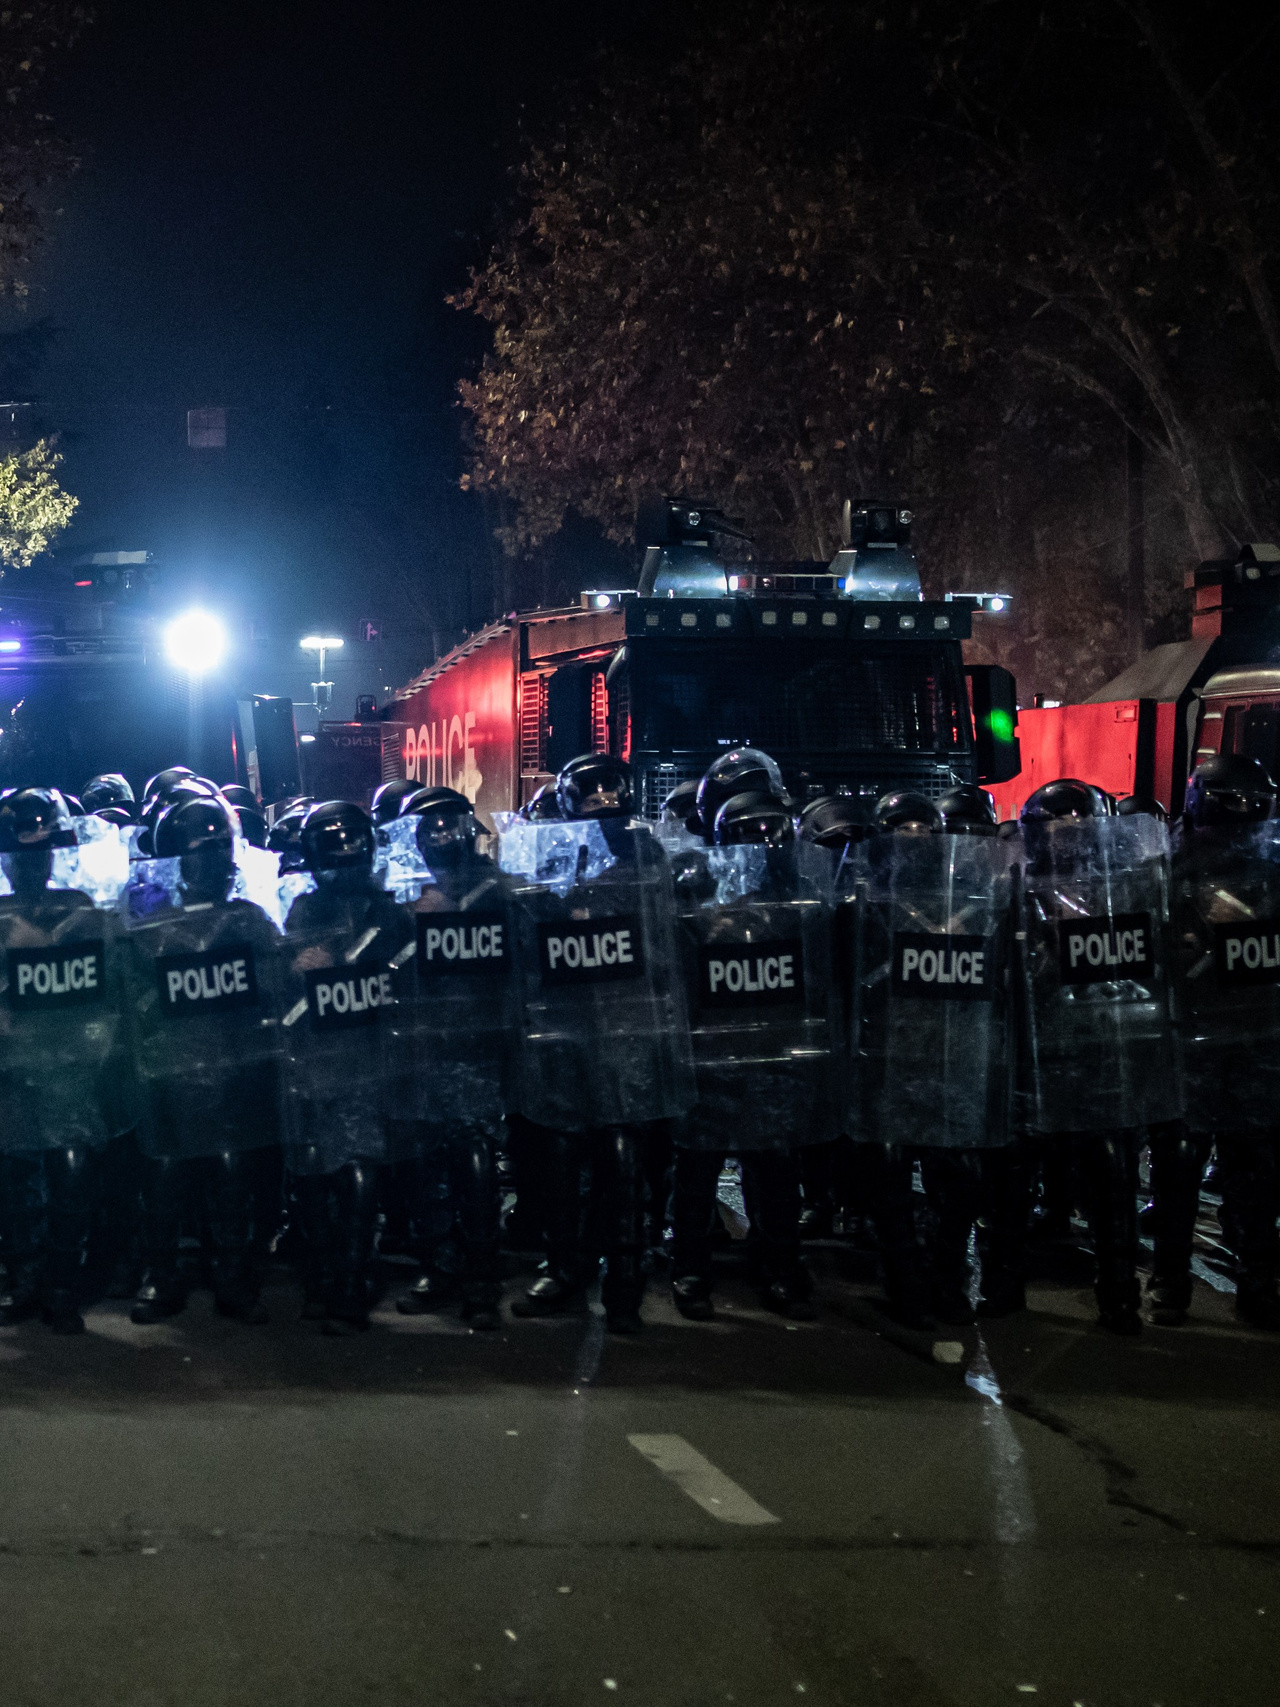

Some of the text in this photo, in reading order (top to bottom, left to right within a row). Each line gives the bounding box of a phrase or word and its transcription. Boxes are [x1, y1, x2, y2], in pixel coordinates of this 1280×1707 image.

[425, 924, 504, 961] POLICE
[547, 929, 634, 969] POLICE
[1068, 928, 1147, 968] POLICE
[17, 955, 98, 996] POLICE
[166, 959, 249, 1003] POLICE
[708, 954, 795, 993] POLICE
[902, 947, 986, 985] POLICE
[316, 973, 395, 1016] POLICE
